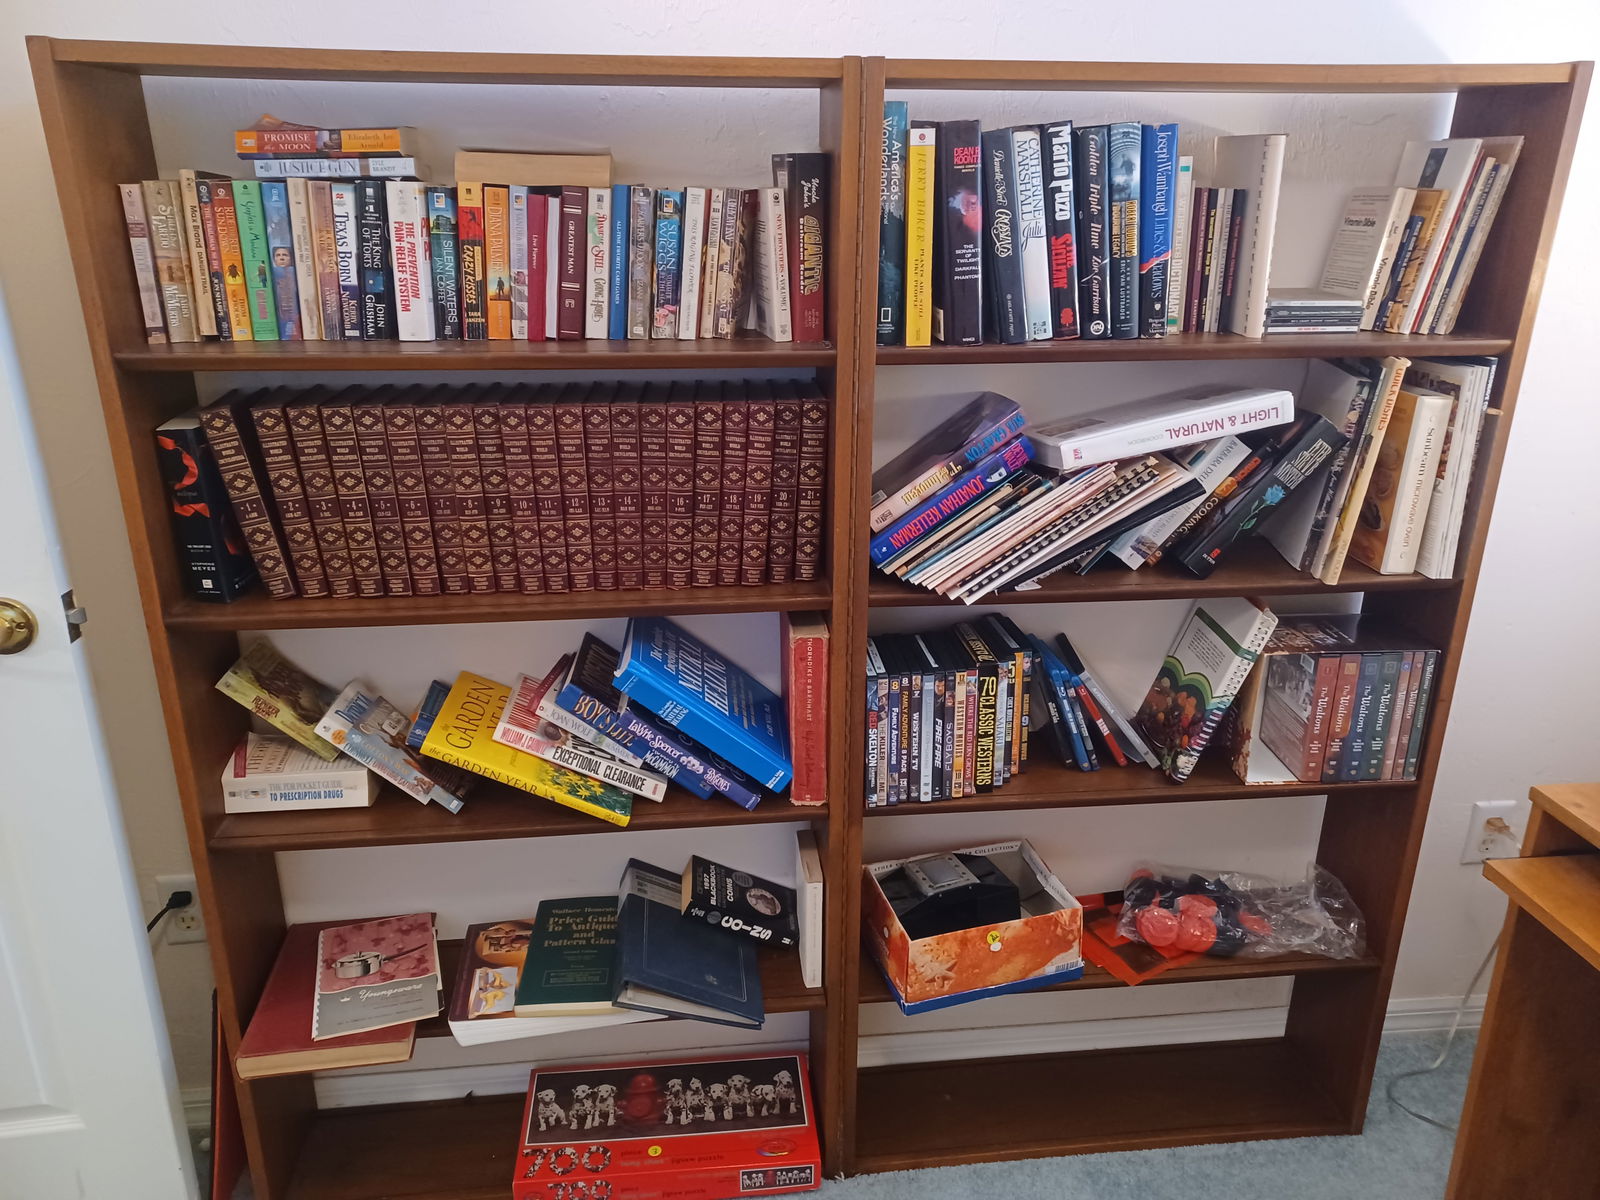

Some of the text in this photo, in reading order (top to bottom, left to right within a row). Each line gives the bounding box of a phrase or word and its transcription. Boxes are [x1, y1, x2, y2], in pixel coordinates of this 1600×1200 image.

[279, 160, 356, 174] JUSTICE GUN
[881, 117, 892, 200] Wonderlands
[890, 141, 901, 200] America's
[992, 150, 1007, 206] Danielle Steel
[1017, 140, 1032, 220] MARSHALL
[1028, 138, 1043, 218] CATHERINE
[1048, 126, 1072, 221] Mario Puzo
[799, 180, 811, 208] John's
[810, 178, 820, 203] Uncle
[917, 153, 927, 242] JERRY BAKER
[152, 214, 170, 250] LAREDO
[215, 206, 229, 254] SUN DOWN
[488, 207, 503, 272] DIANA PALMER
[797, 218, 806, 260] Bathroom
[990, 209, 1013, 258] CROSSINGS
[1021, 221, 1046, 253] Julie
[1088, 135, 1102, 314] Golden Triple Time Zoe Garrison
[1126, 201, 1137, 256] ROBERT LUDLUM'S
[335, 212, 353, 283] TEXAS BORN
[362, 228, 373, 267] OF TORTS
[372, 228, 382, 268] THE KING
[394, 221, 410, 312] PAIN-RELIEF SYSTEM
[406, 223, 420, 299] THE PREVENTION
[658, 222, 668, 271] WIGGS
[667, 224, 677, 269] SUSAN
[800, 215, 825, 296] GIGANTIC
[1051, 234, 1073, 289] SICILIAN
[1065, 246, 1074, 268] THE
[1168, 199, 1186, 316] WEBSTER'S DICTIONARY
[434, 257, 446, 305] JAN COFFEY
[443, 240, 458, 322] SILENT WATERS
[464, 245, 476, 304] CRAZY KISSES
[1365, 256, 1389, 311] Vitamin Bible
[342, 292, 351, 328] NEWCOMB
[349, 300, 358, 323] KERRY
[366, 294, 376, 335] GRISHAM
[376, 304, 386, 327] JOHN
[591, 278, 606, 322] GOING HOME
[1432, 287, 1450, 328] BUCKINGHAM
[1377, 367, 1404, 431] QUICK DISHES
[964, 413, 1025, 463] SUE GRAFTON
[1166, 407, 1279, 439] LIGHT & NATURAL
[1003, 452, 1021, 472] WALTZ
[1402, 427, 1436, 548] Sunbeam microwave oven
[889, 476, 985, 549] JONATHAN KELLERMAN
[1177, 498, 1218, 533] COOKING
[679, 638, 702, 698] NATURAL
[704, 652, 730, 716] HEALING
[980, 677, 996, 696] 70
[446, 680, 495, 749] GARDEN
[869, 712, 878, 728] RED
[1313, 697, 1328, 735] Waltons
[1335, 694, 1351, 733] Waltons
[1356, 695, 1372, 733] Waltons
[1375, 693, 1391, 732] Waltons
[628, 720, 683, 757] LaVyrle Spencer
[869, 728, 878, 766] SKELTON
[977, 696, 993, 785] CLASSIC WESTERNS
[429, 746, 538, 794] the GARDEN YEAR
[552, 746, 647, 792] EXCEPTIONAL CLEARANCE
[643, 751, 680, 778] McCAMMON
[704, 768, 731, 791] BYGONES
[912, 759, 918, 770] TV
[270, 790, 344, 802] TO PRESCRIPTION DRUGS
[975, 845, 1014, 854] COLLECTION
[549, 915, 618, 924] Price Guid
[573, 930, 595, 939] and
[721, 916, 773, 941] COINS
[522, 1145, 611, 1178] 700
[548, 1180, 613, 1200] 700
